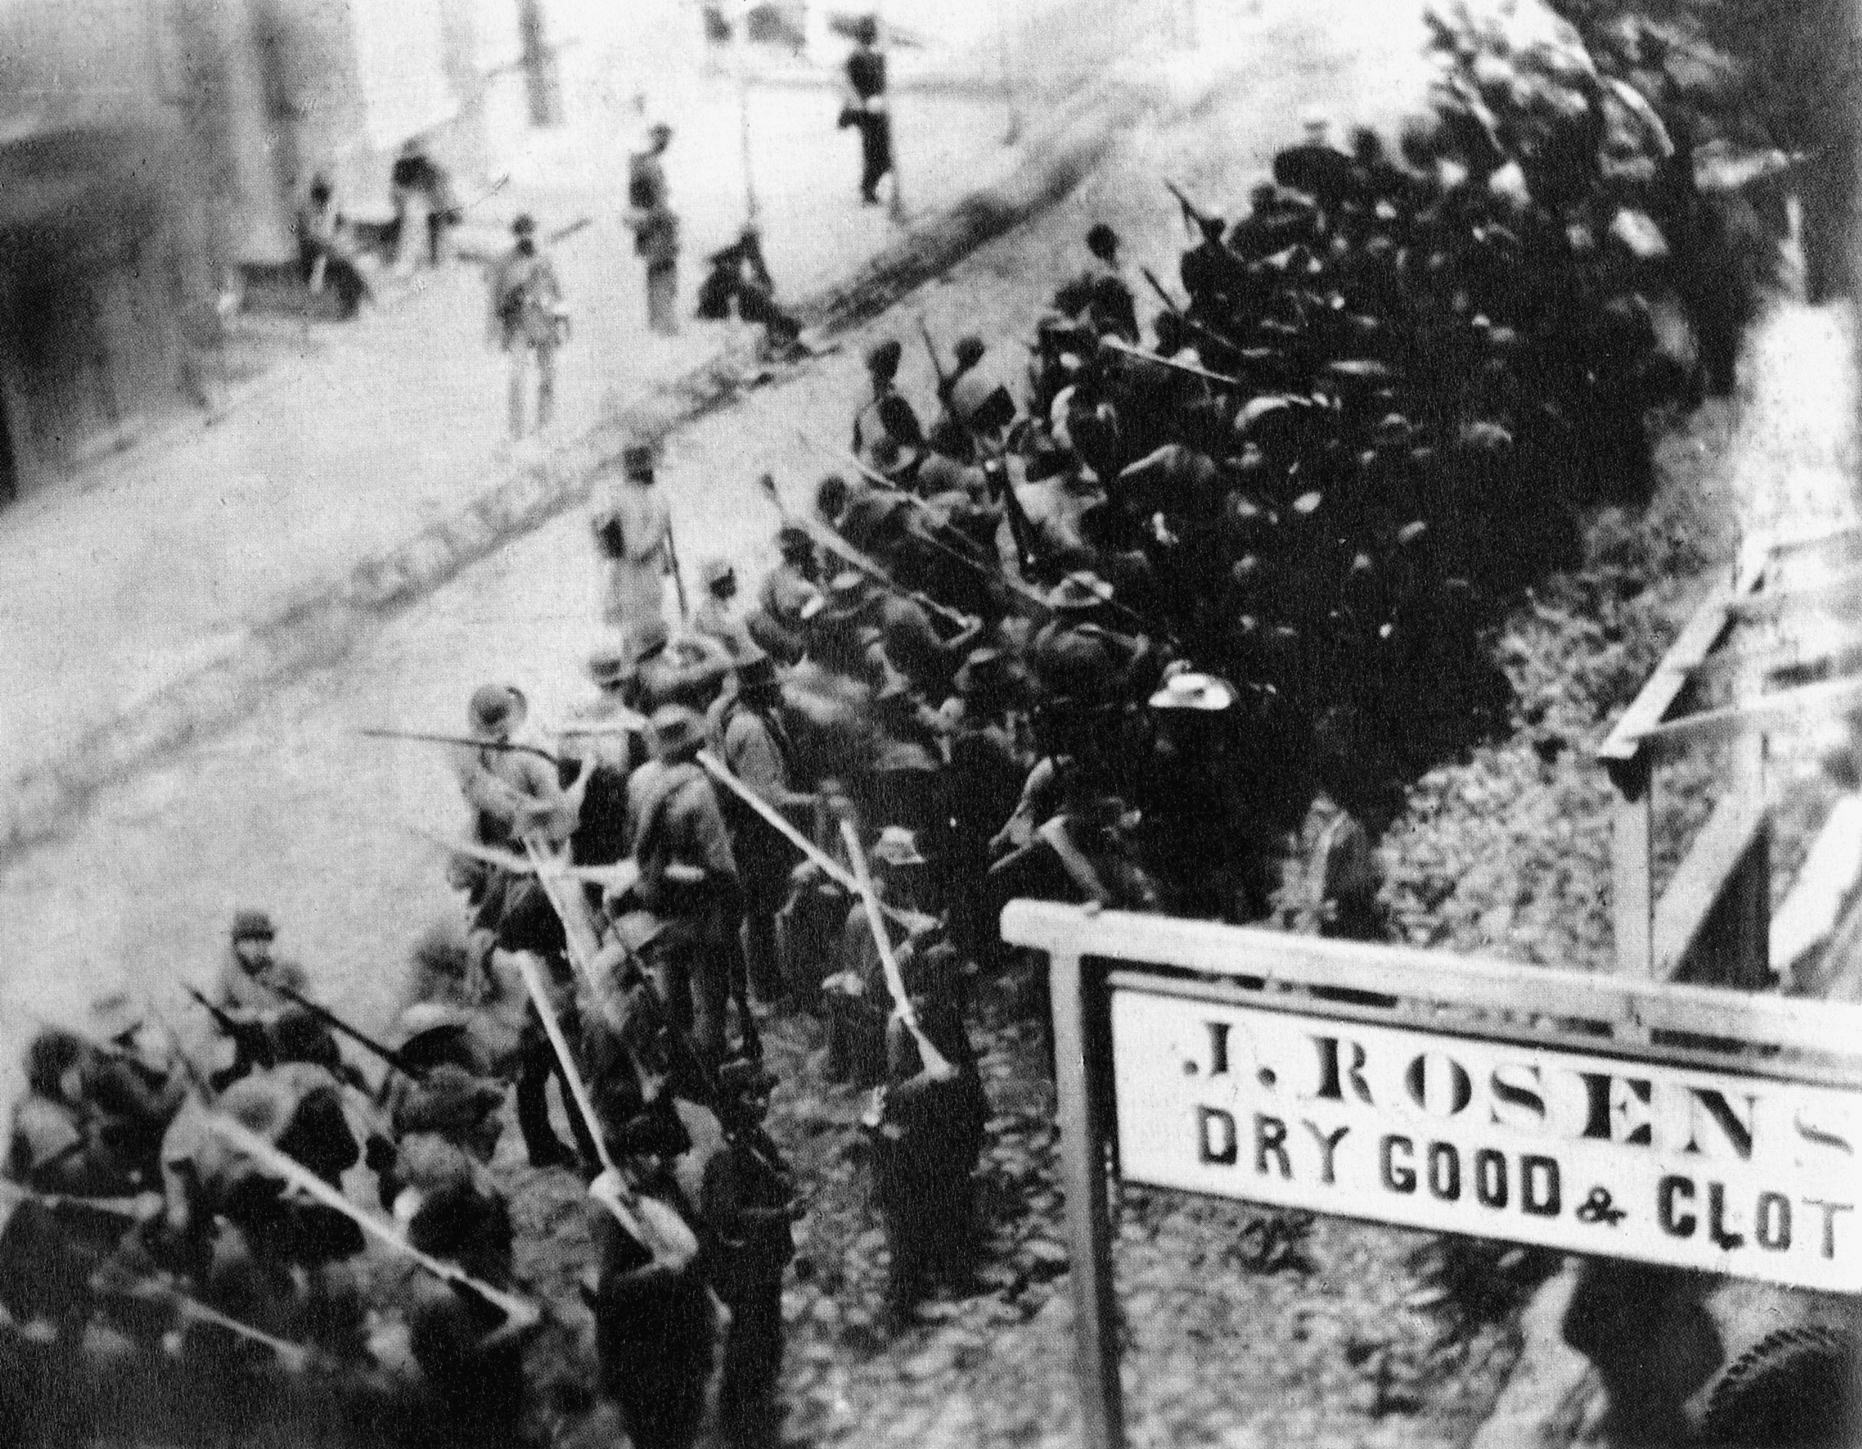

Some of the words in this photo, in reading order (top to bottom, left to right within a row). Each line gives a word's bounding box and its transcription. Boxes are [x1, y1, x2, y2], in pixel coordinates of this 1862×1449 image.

[1195, 1103, 1351, 1185] DRY
[1378, 1133, 1563, 1218] GOOD
[1575, 1184, 1627, 1227] &
[1657, 1174, 1855, 1261] CLOT
